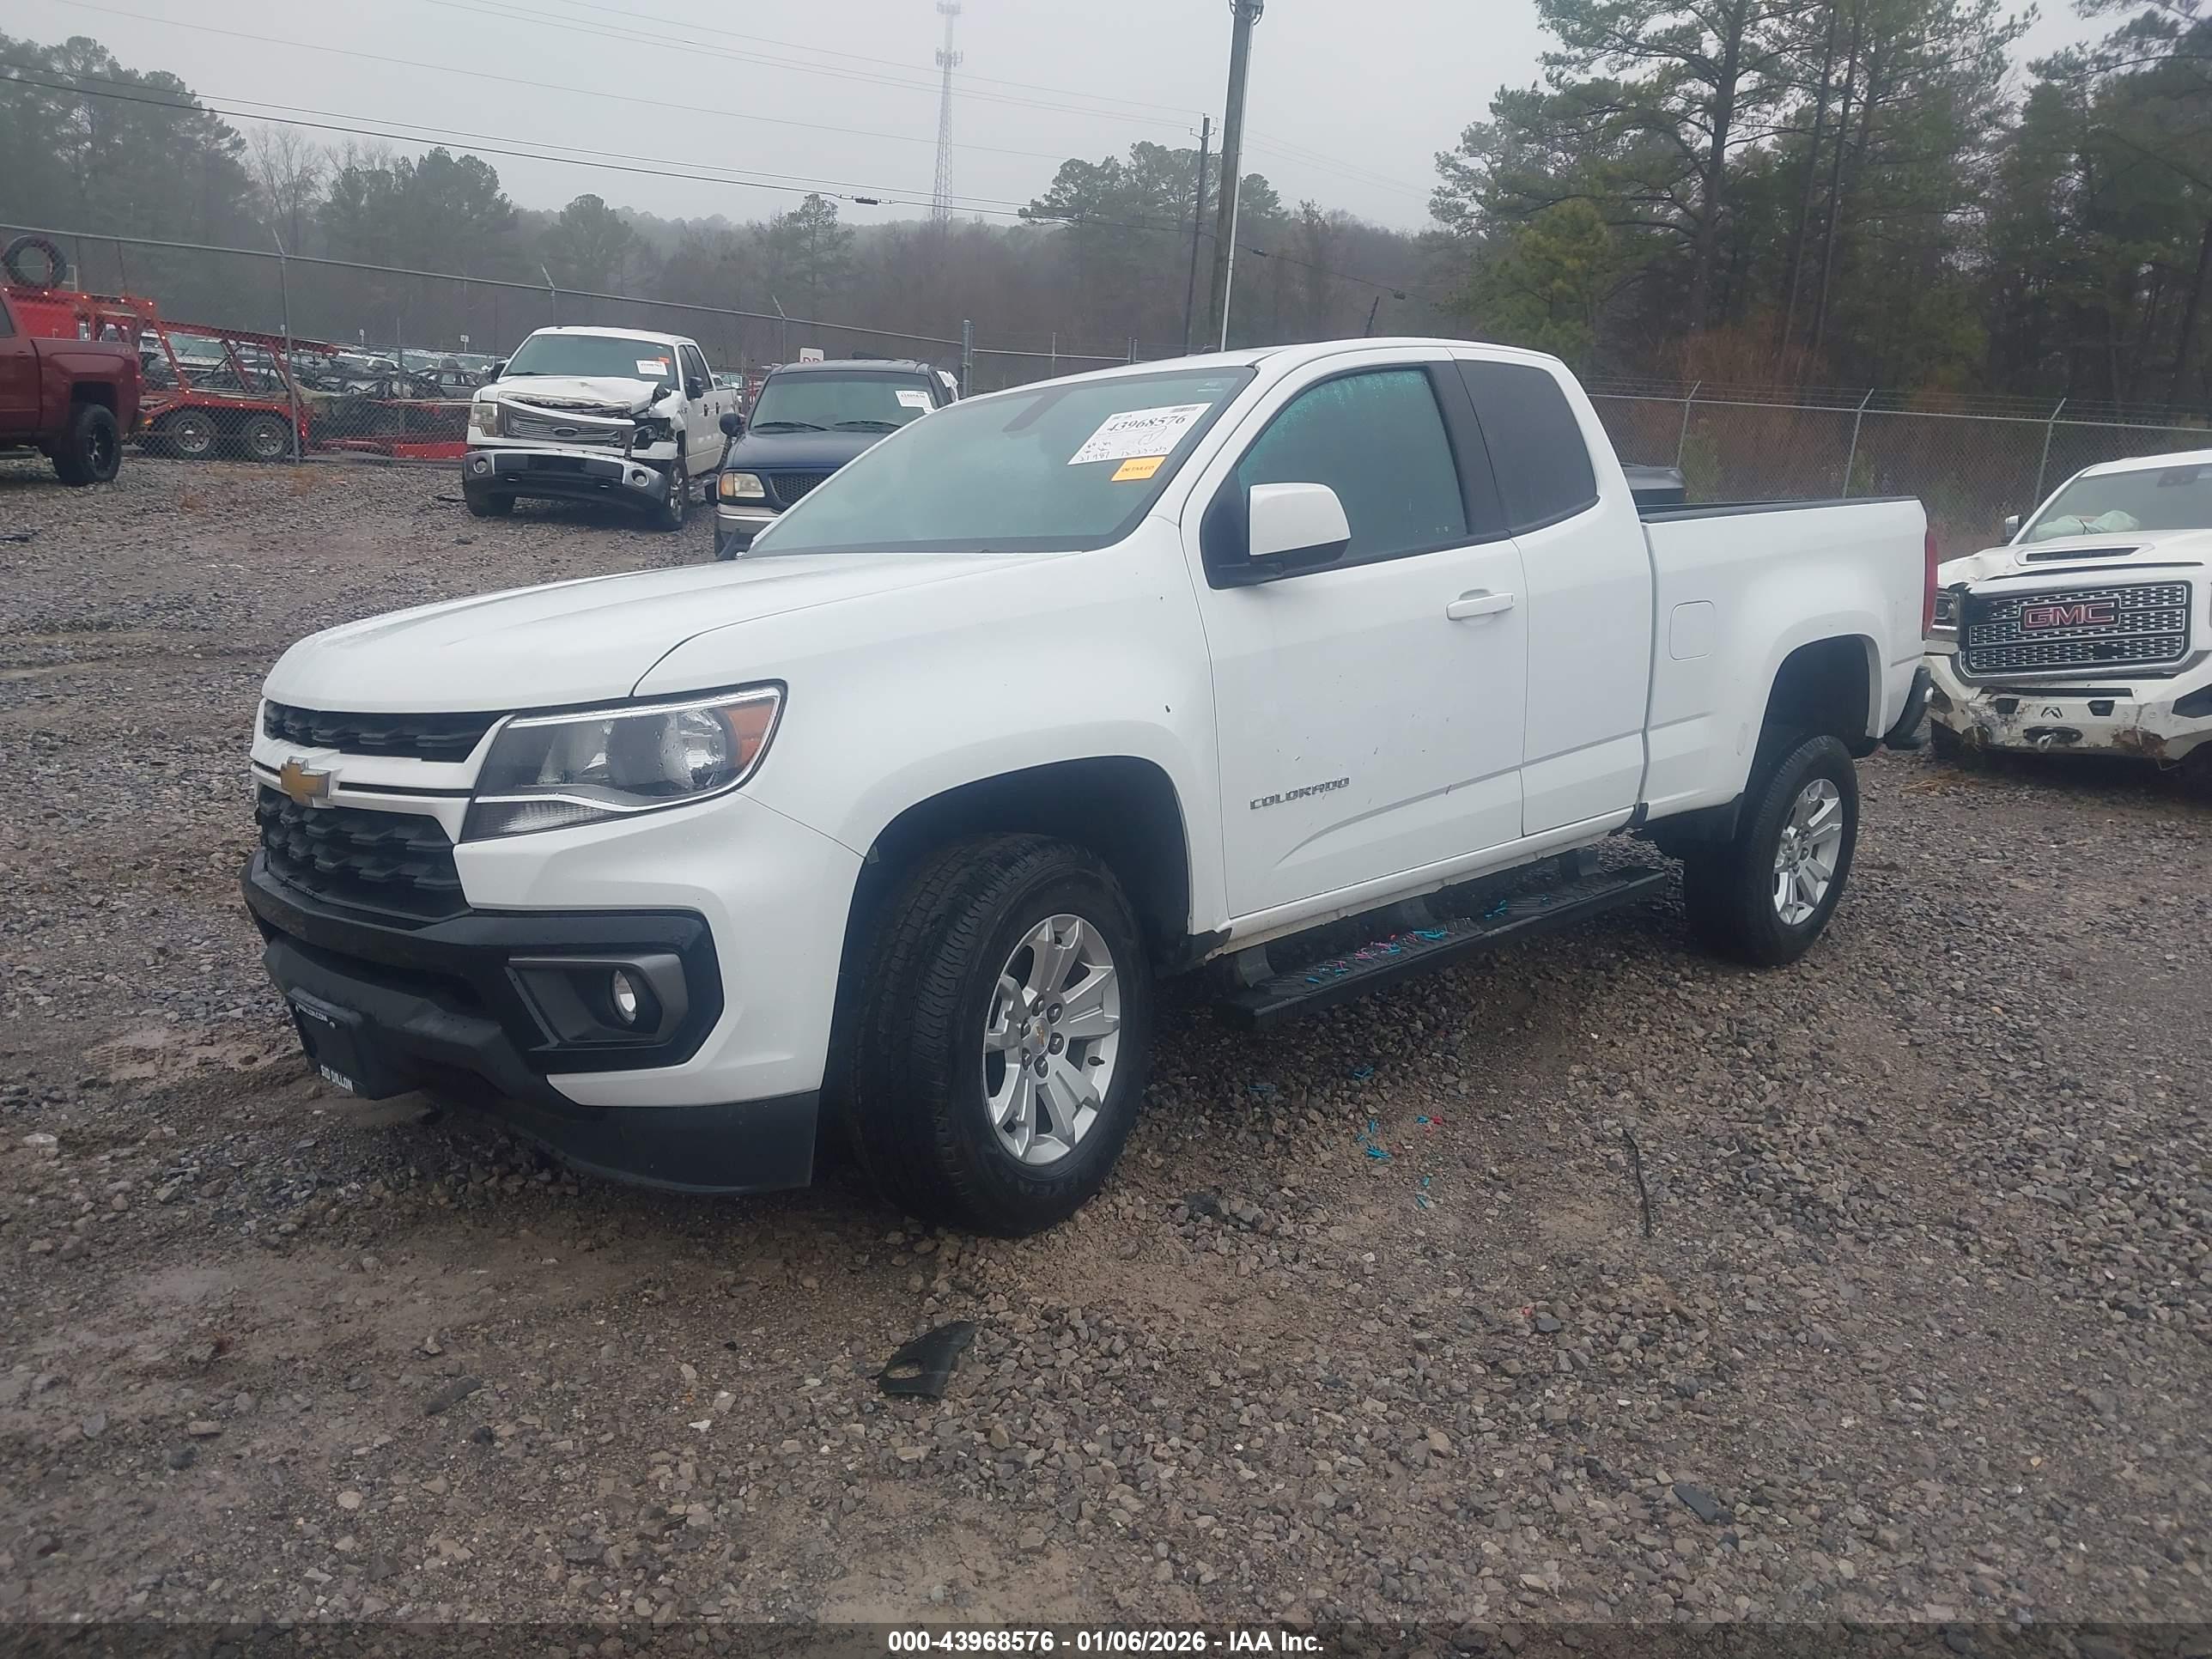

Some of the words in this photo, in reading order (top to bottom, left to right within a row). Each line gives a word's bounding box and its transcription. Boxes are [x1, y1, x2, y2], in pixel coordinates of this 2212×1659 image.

[1107, 415, 1188, 432] 43968576
[2024, 602, 2115, 629] GMC
[1249, 776, 1350, 810] COLORADO
[331, 1070, 354, 1092] DILLON
